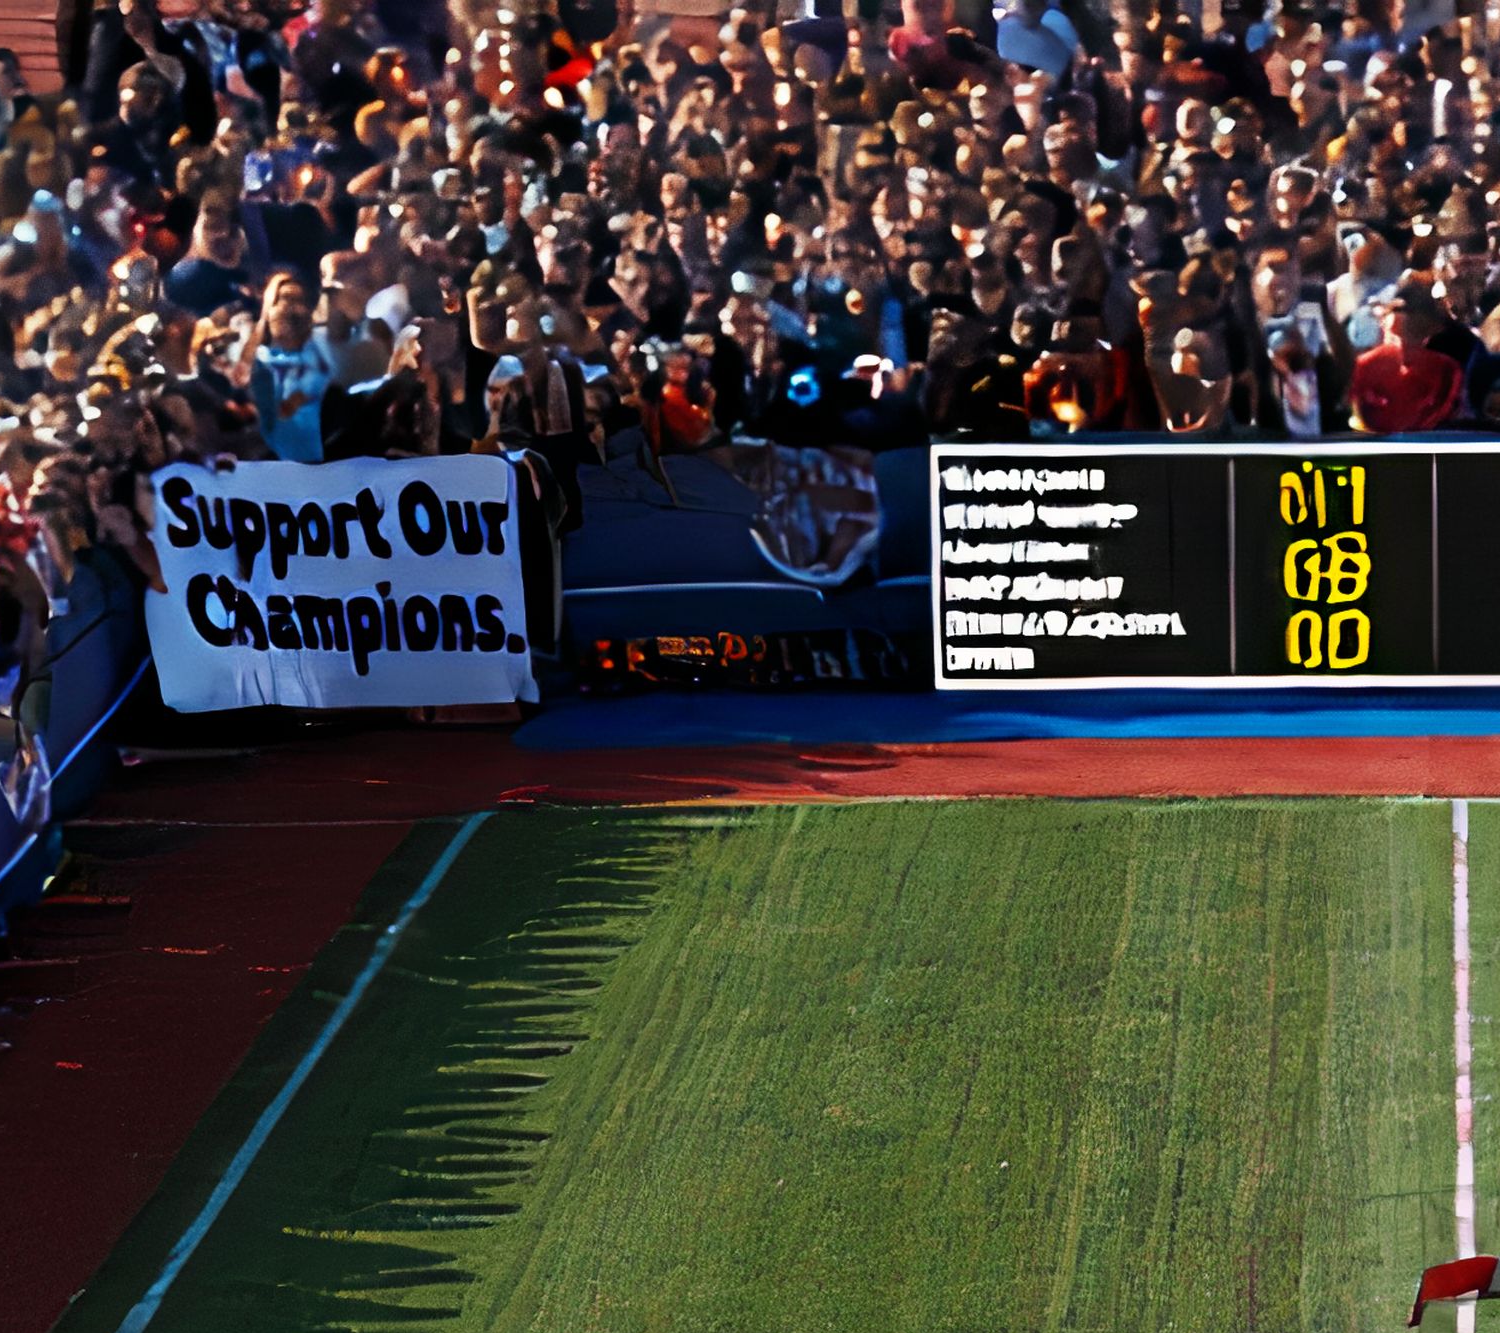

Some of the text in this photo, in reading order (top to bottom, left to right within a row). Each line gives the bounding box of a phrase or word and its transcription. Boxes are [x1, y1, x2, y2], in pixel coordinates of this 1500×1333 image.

[162, 475, 509, 580] Support Our
[186, 572, 528, 677] Champions.
